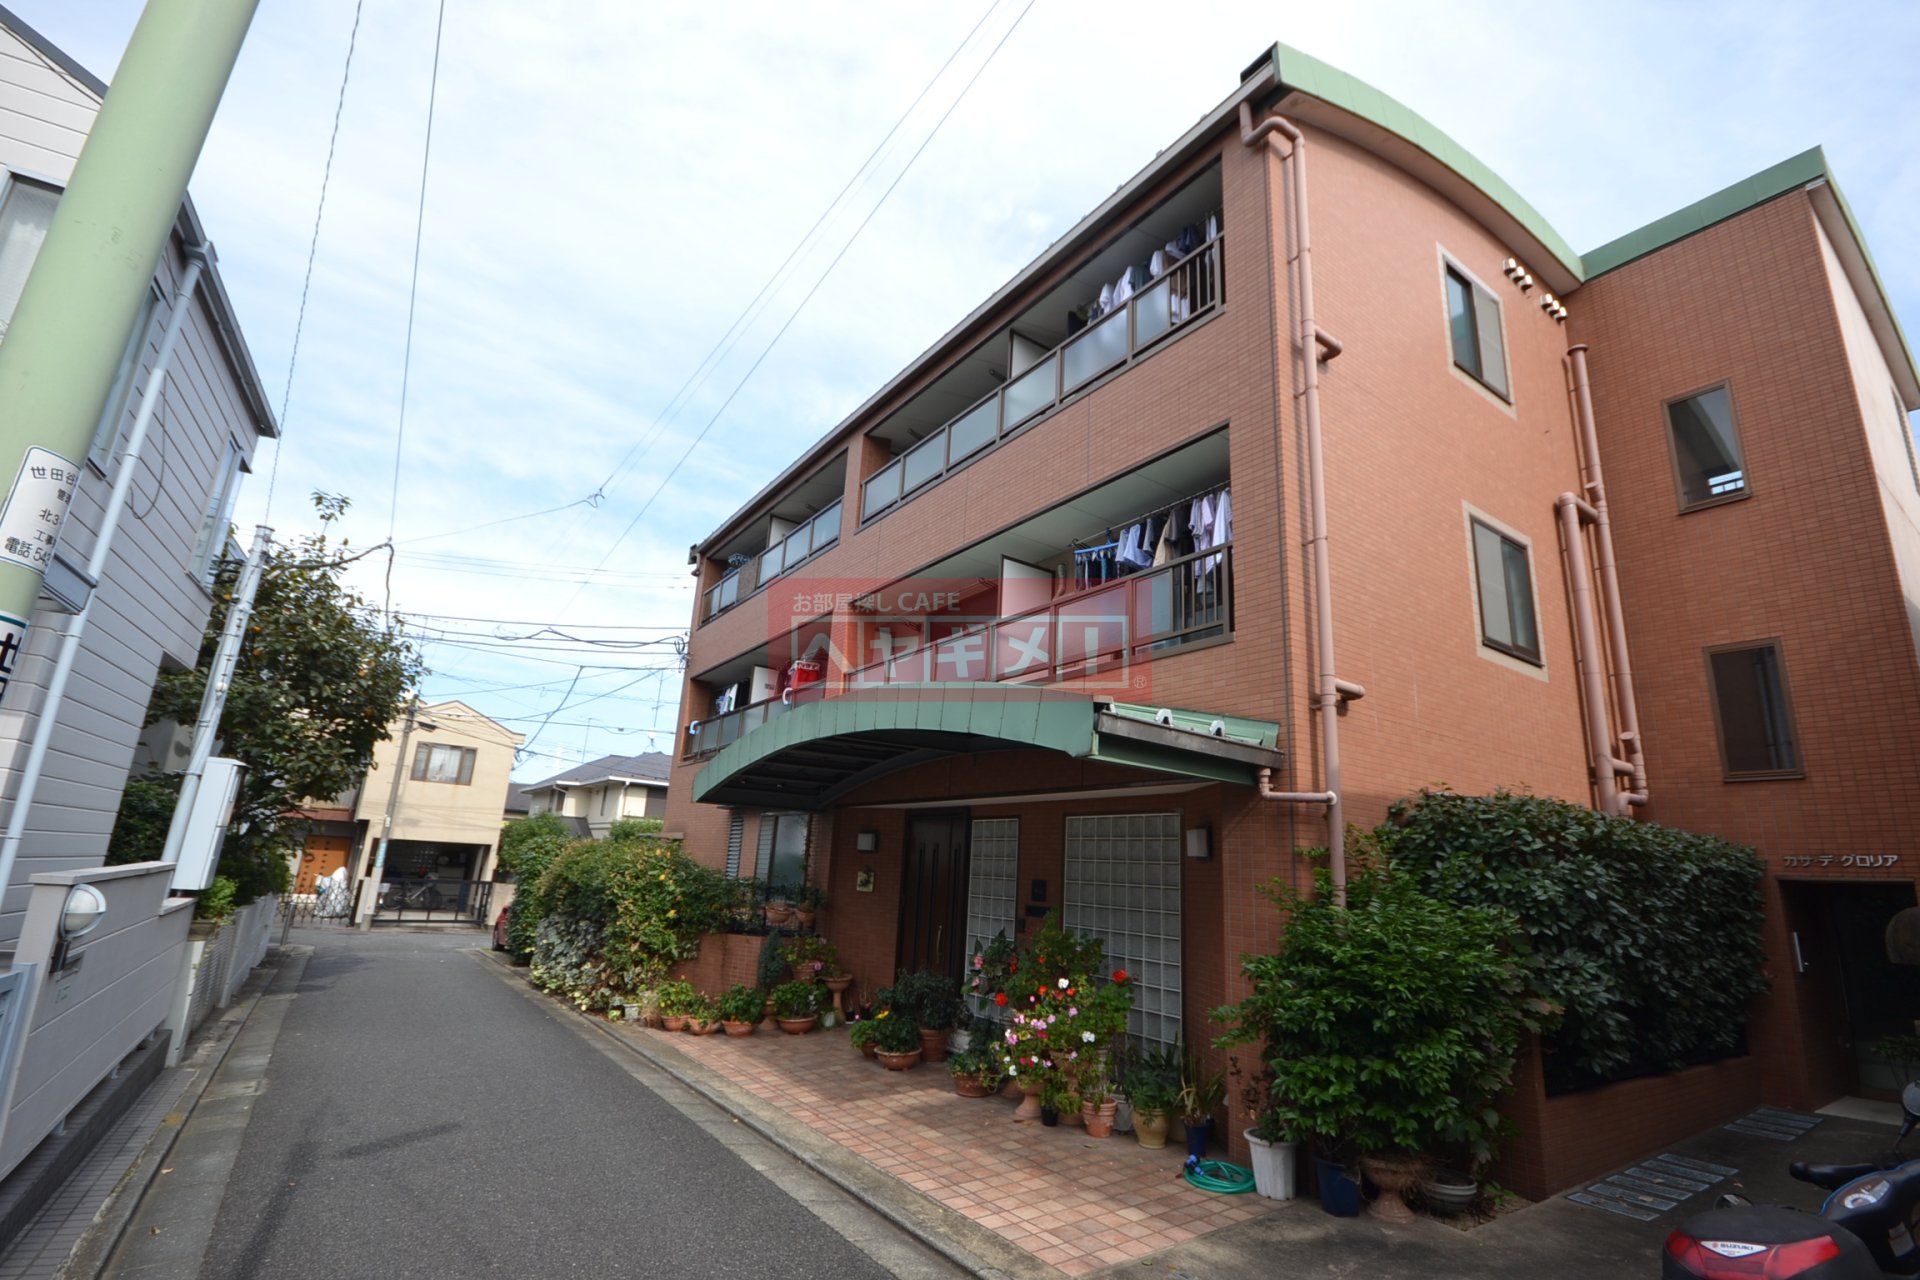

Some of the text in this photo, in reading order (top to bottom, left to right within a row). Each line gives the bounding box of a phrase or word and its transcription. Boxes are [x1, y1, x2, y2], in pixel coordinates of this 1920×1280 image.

[30, 465, 79, 487] 世田谷
[4, 536, 33, 558] 電話
